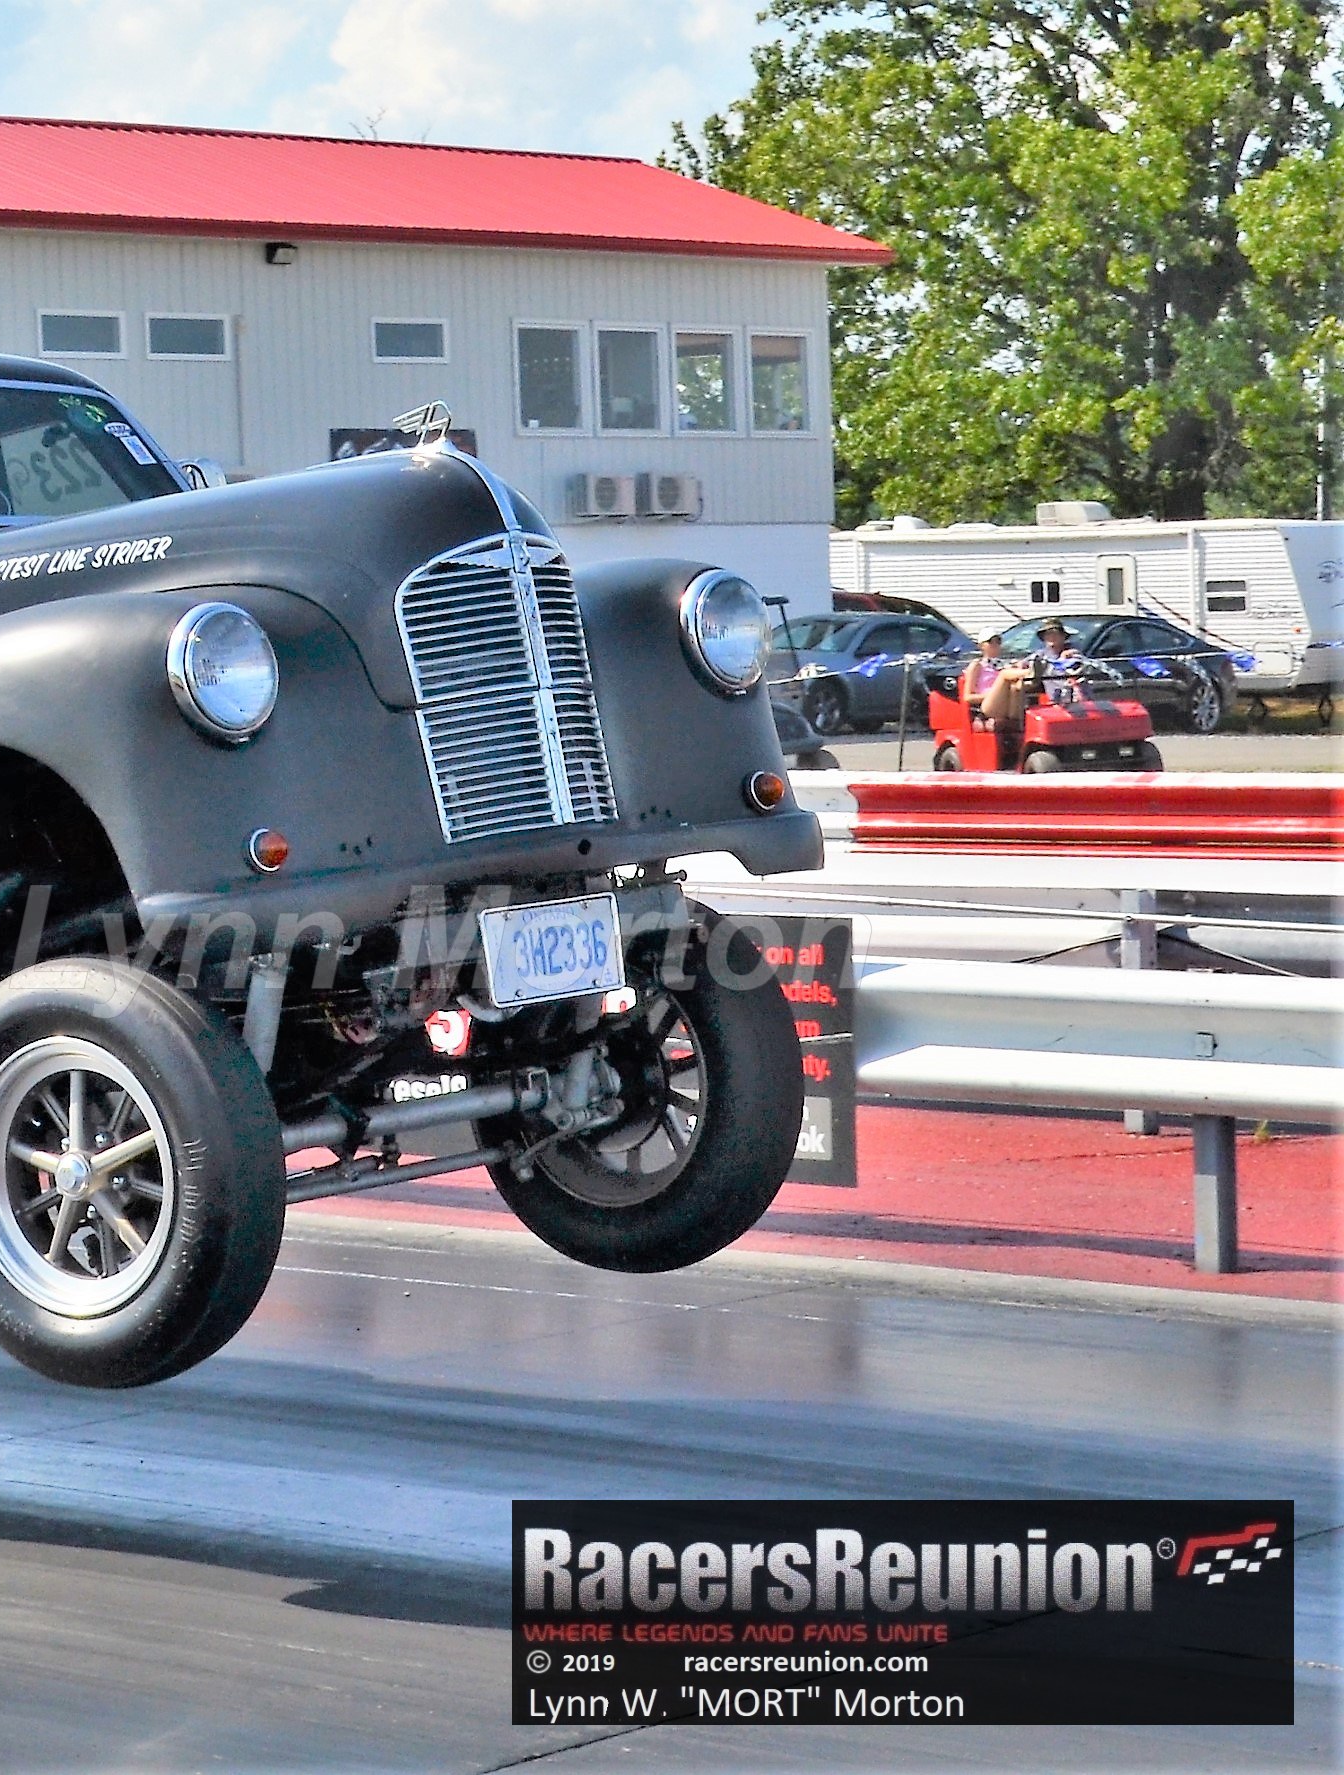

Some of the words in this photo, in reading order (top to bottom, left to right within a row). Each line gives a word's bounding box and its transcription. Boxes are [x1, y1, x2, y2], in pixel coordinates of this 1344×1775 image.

[47, 545, 93, 575] LINE
[90, 535, 173, 569] STRIPER
[765, 946, 795, 967] on
[798, 943, 824, 967] all
